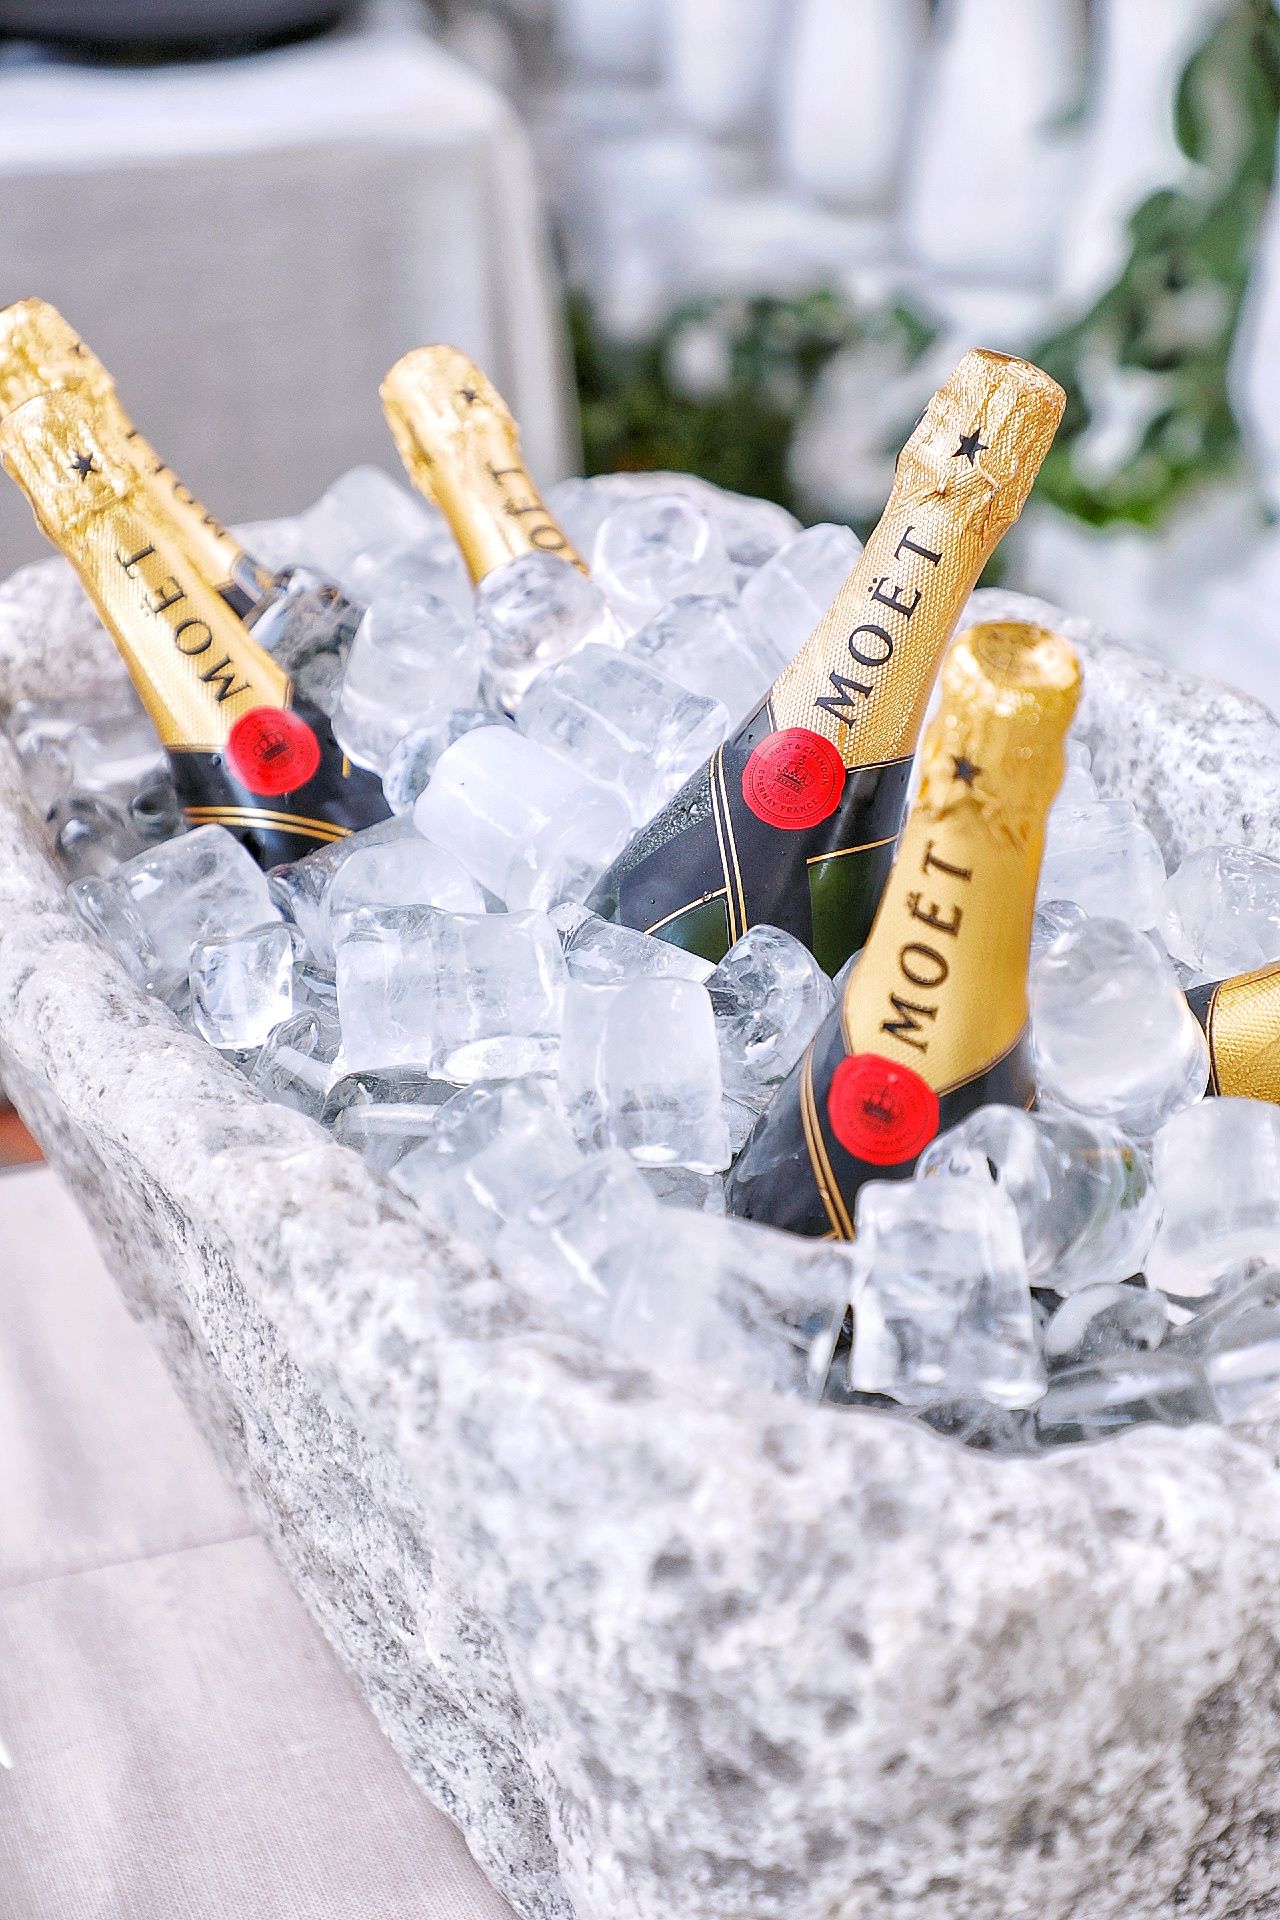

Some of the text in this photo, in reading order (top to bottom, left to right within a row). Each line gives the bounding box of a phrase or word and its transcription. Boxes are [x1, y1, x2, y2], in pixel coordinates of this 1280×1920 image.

[116, 542, 251, 705] MOËT
[814, 525, 943, 730] MOËT
[780, 798, 818, 813] FRANCE
[804, 746, 829, 786] CHANDON
[879, 839, 973, 1054] MOËT
